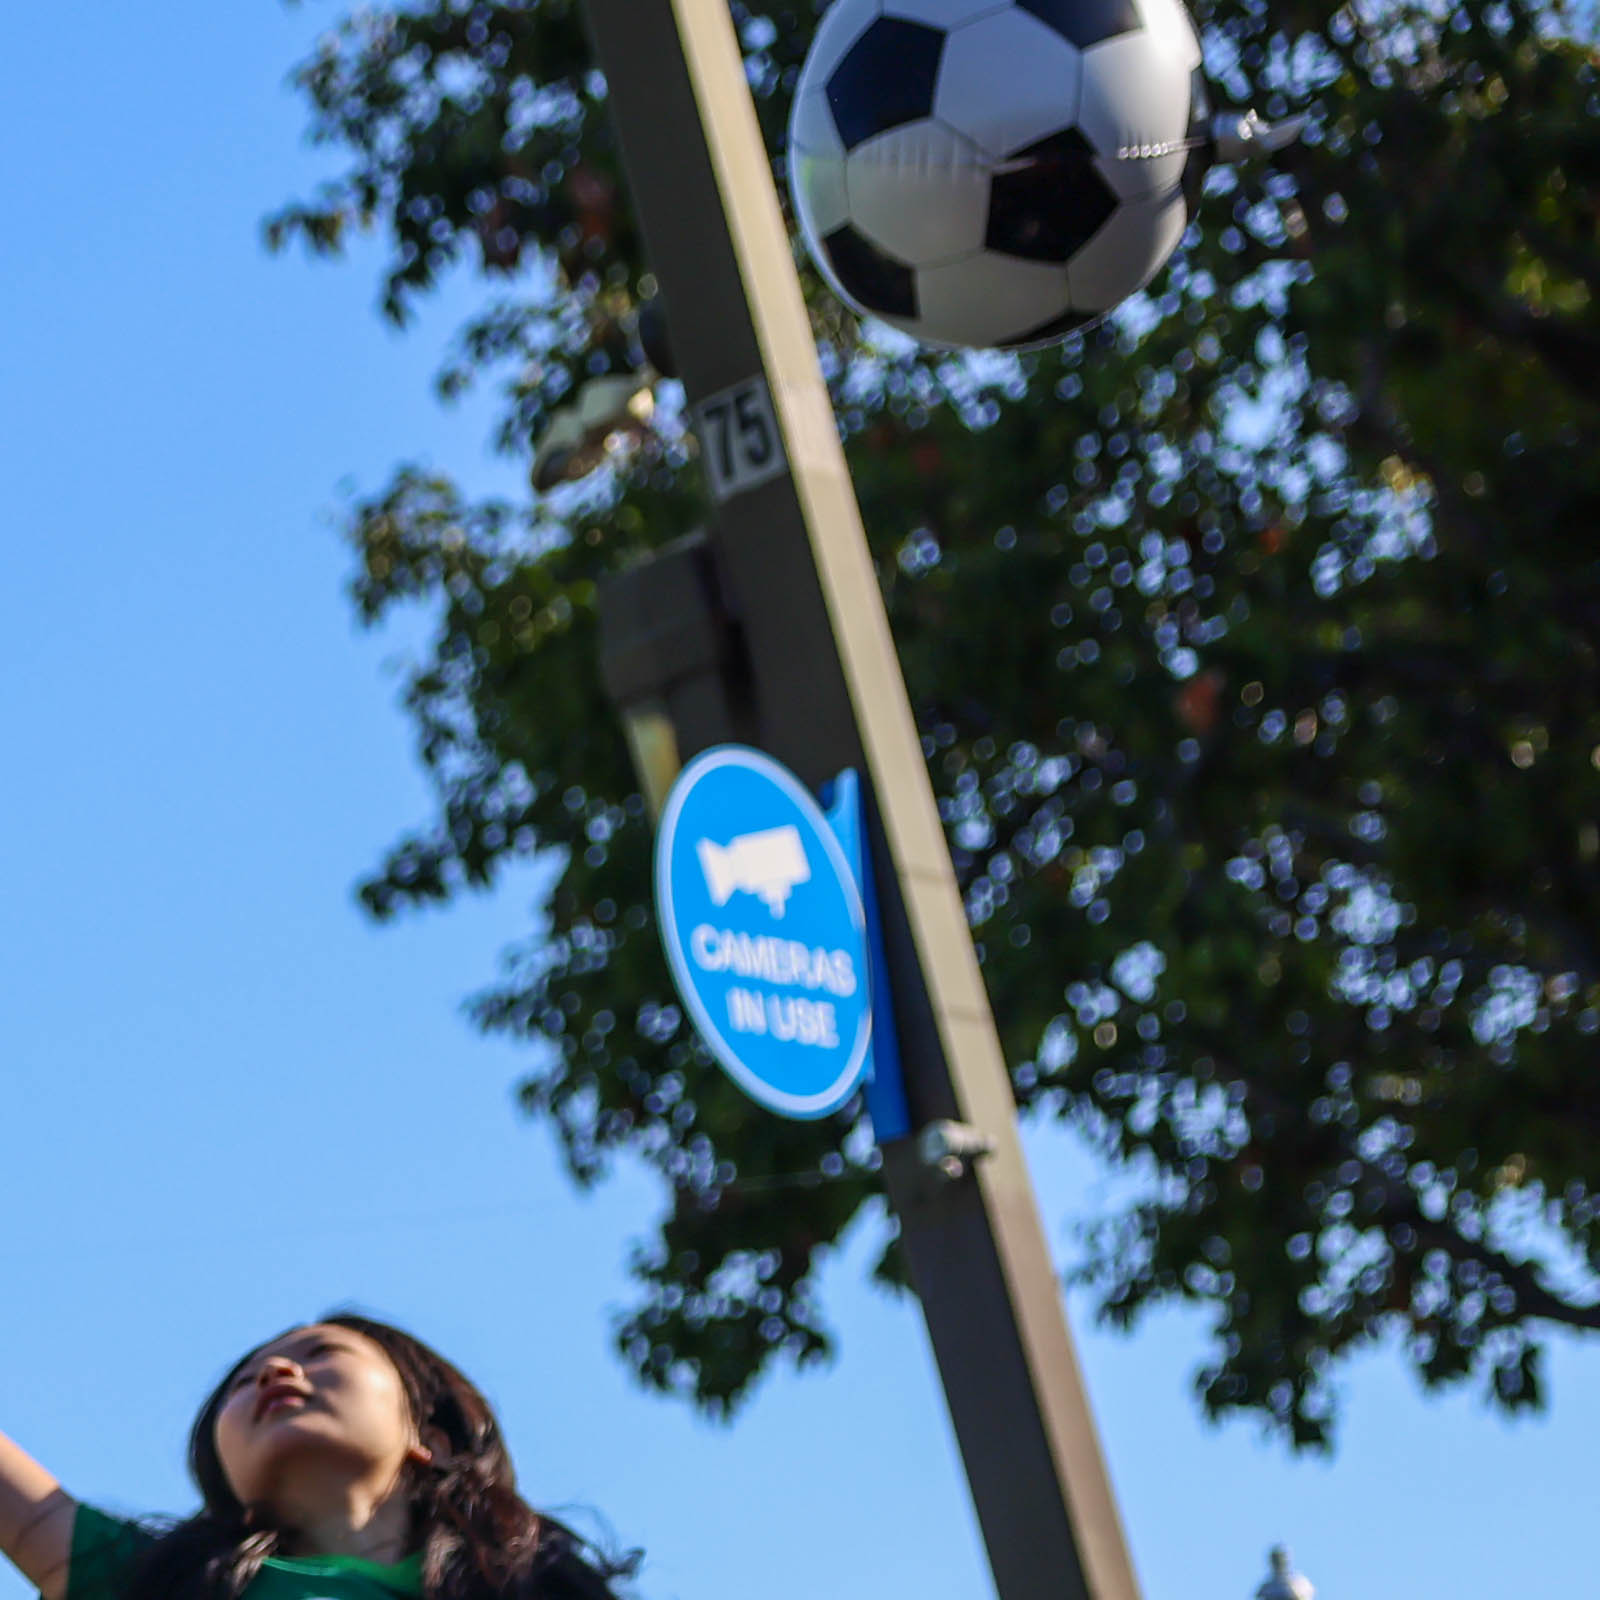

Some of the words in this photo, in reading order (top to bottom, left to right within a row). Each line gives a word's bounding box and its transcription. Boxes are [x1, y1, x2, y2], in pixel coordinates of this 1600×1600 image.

[702, 388, 773, 482] 75
[690, 922, 858, 998] CAMERAS
[725, 986, 767, 1036] IN
[766, 993, 841, 1050] USE
